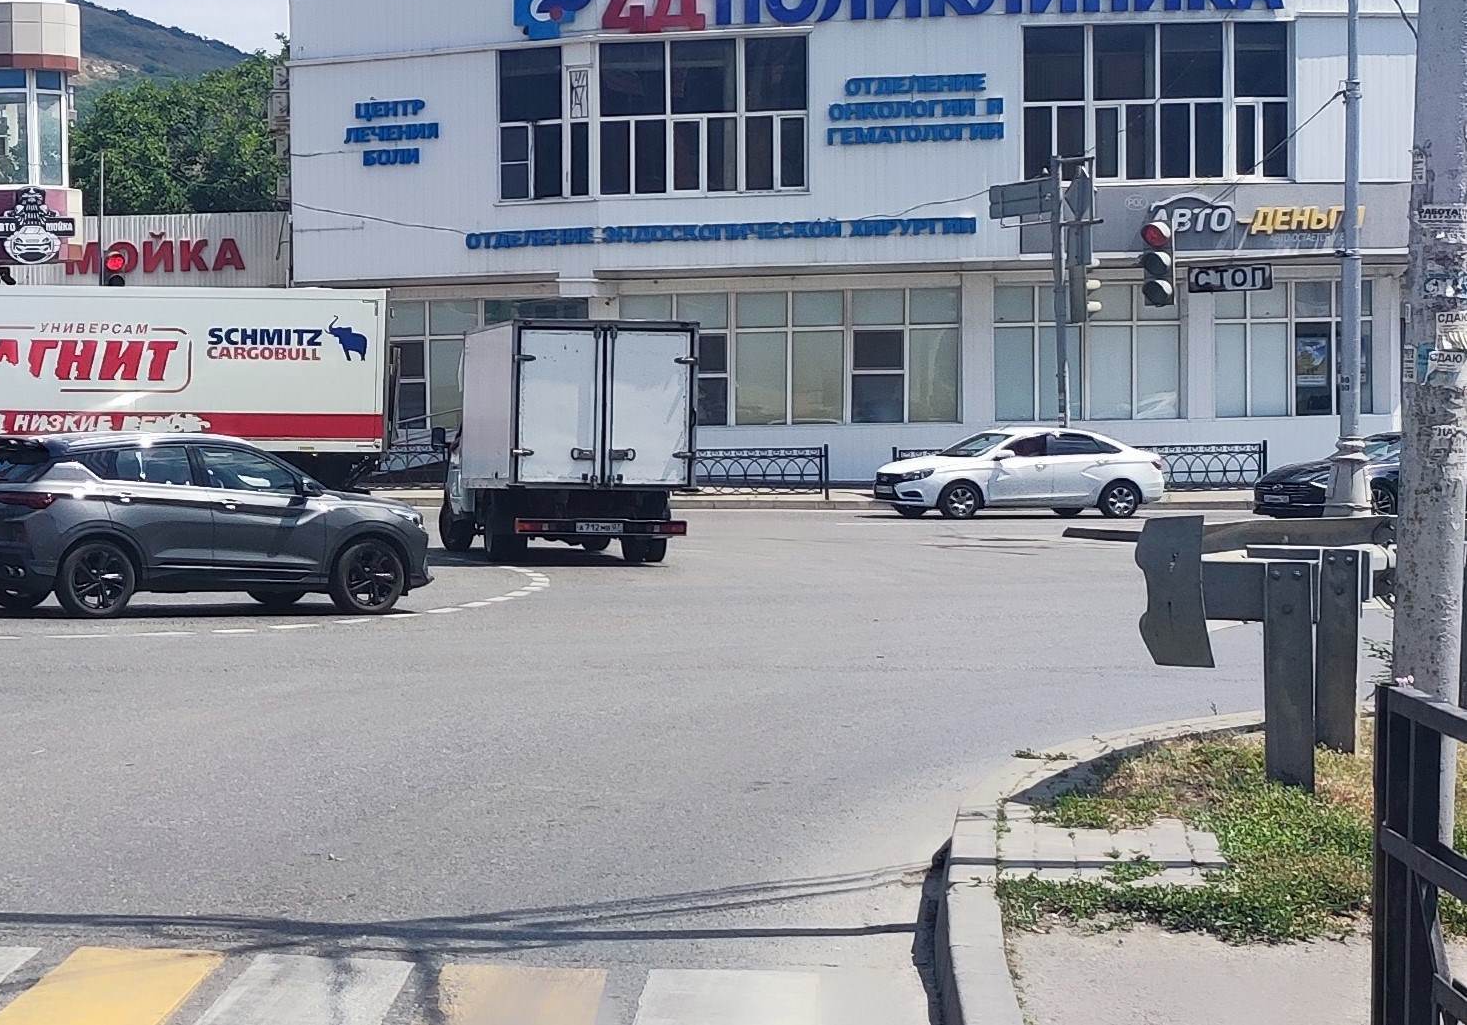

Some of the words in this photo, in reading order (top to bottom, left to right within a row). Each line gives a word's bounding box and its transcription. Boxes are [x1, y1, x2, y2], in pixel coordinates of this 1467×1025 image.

[845, 73, 986, 96] ОТДЕЛЕНИЕ
[355, 99, 425, 121] ЦЕНТР
[829, 98, 975, 121] ОНКОЛОГИИ
[987, 97, 1003, 115] И
[344, 122, 439, 144] ЛЕЧЕНИЯ
[827, 122, 1004, 146] ГЕМАТОЛОГИИ
[363, 148, 420, 166] БОЛИ
[45, 221, 74, 232] МОЙКА
[465, 227, 595, 249] ОТДЕЛЕНИЕ
[602, 220, 842, 244] ЭНДОСКОПИЧЕСКОЙ
[849, 217, 976, 238] ХИРУРГИИ
[66, 232, 245, 275] МОЙКА
[1195, 267, 1266, 287] СТОП
[40, 322, 148, 334] УНИВЕРСАМ
[208, 327, 323, 346] SCHMITZ
[207, 347, 321, 361] CARGOBULL
[14, 413, 112, 433] НИЗКИЕ
